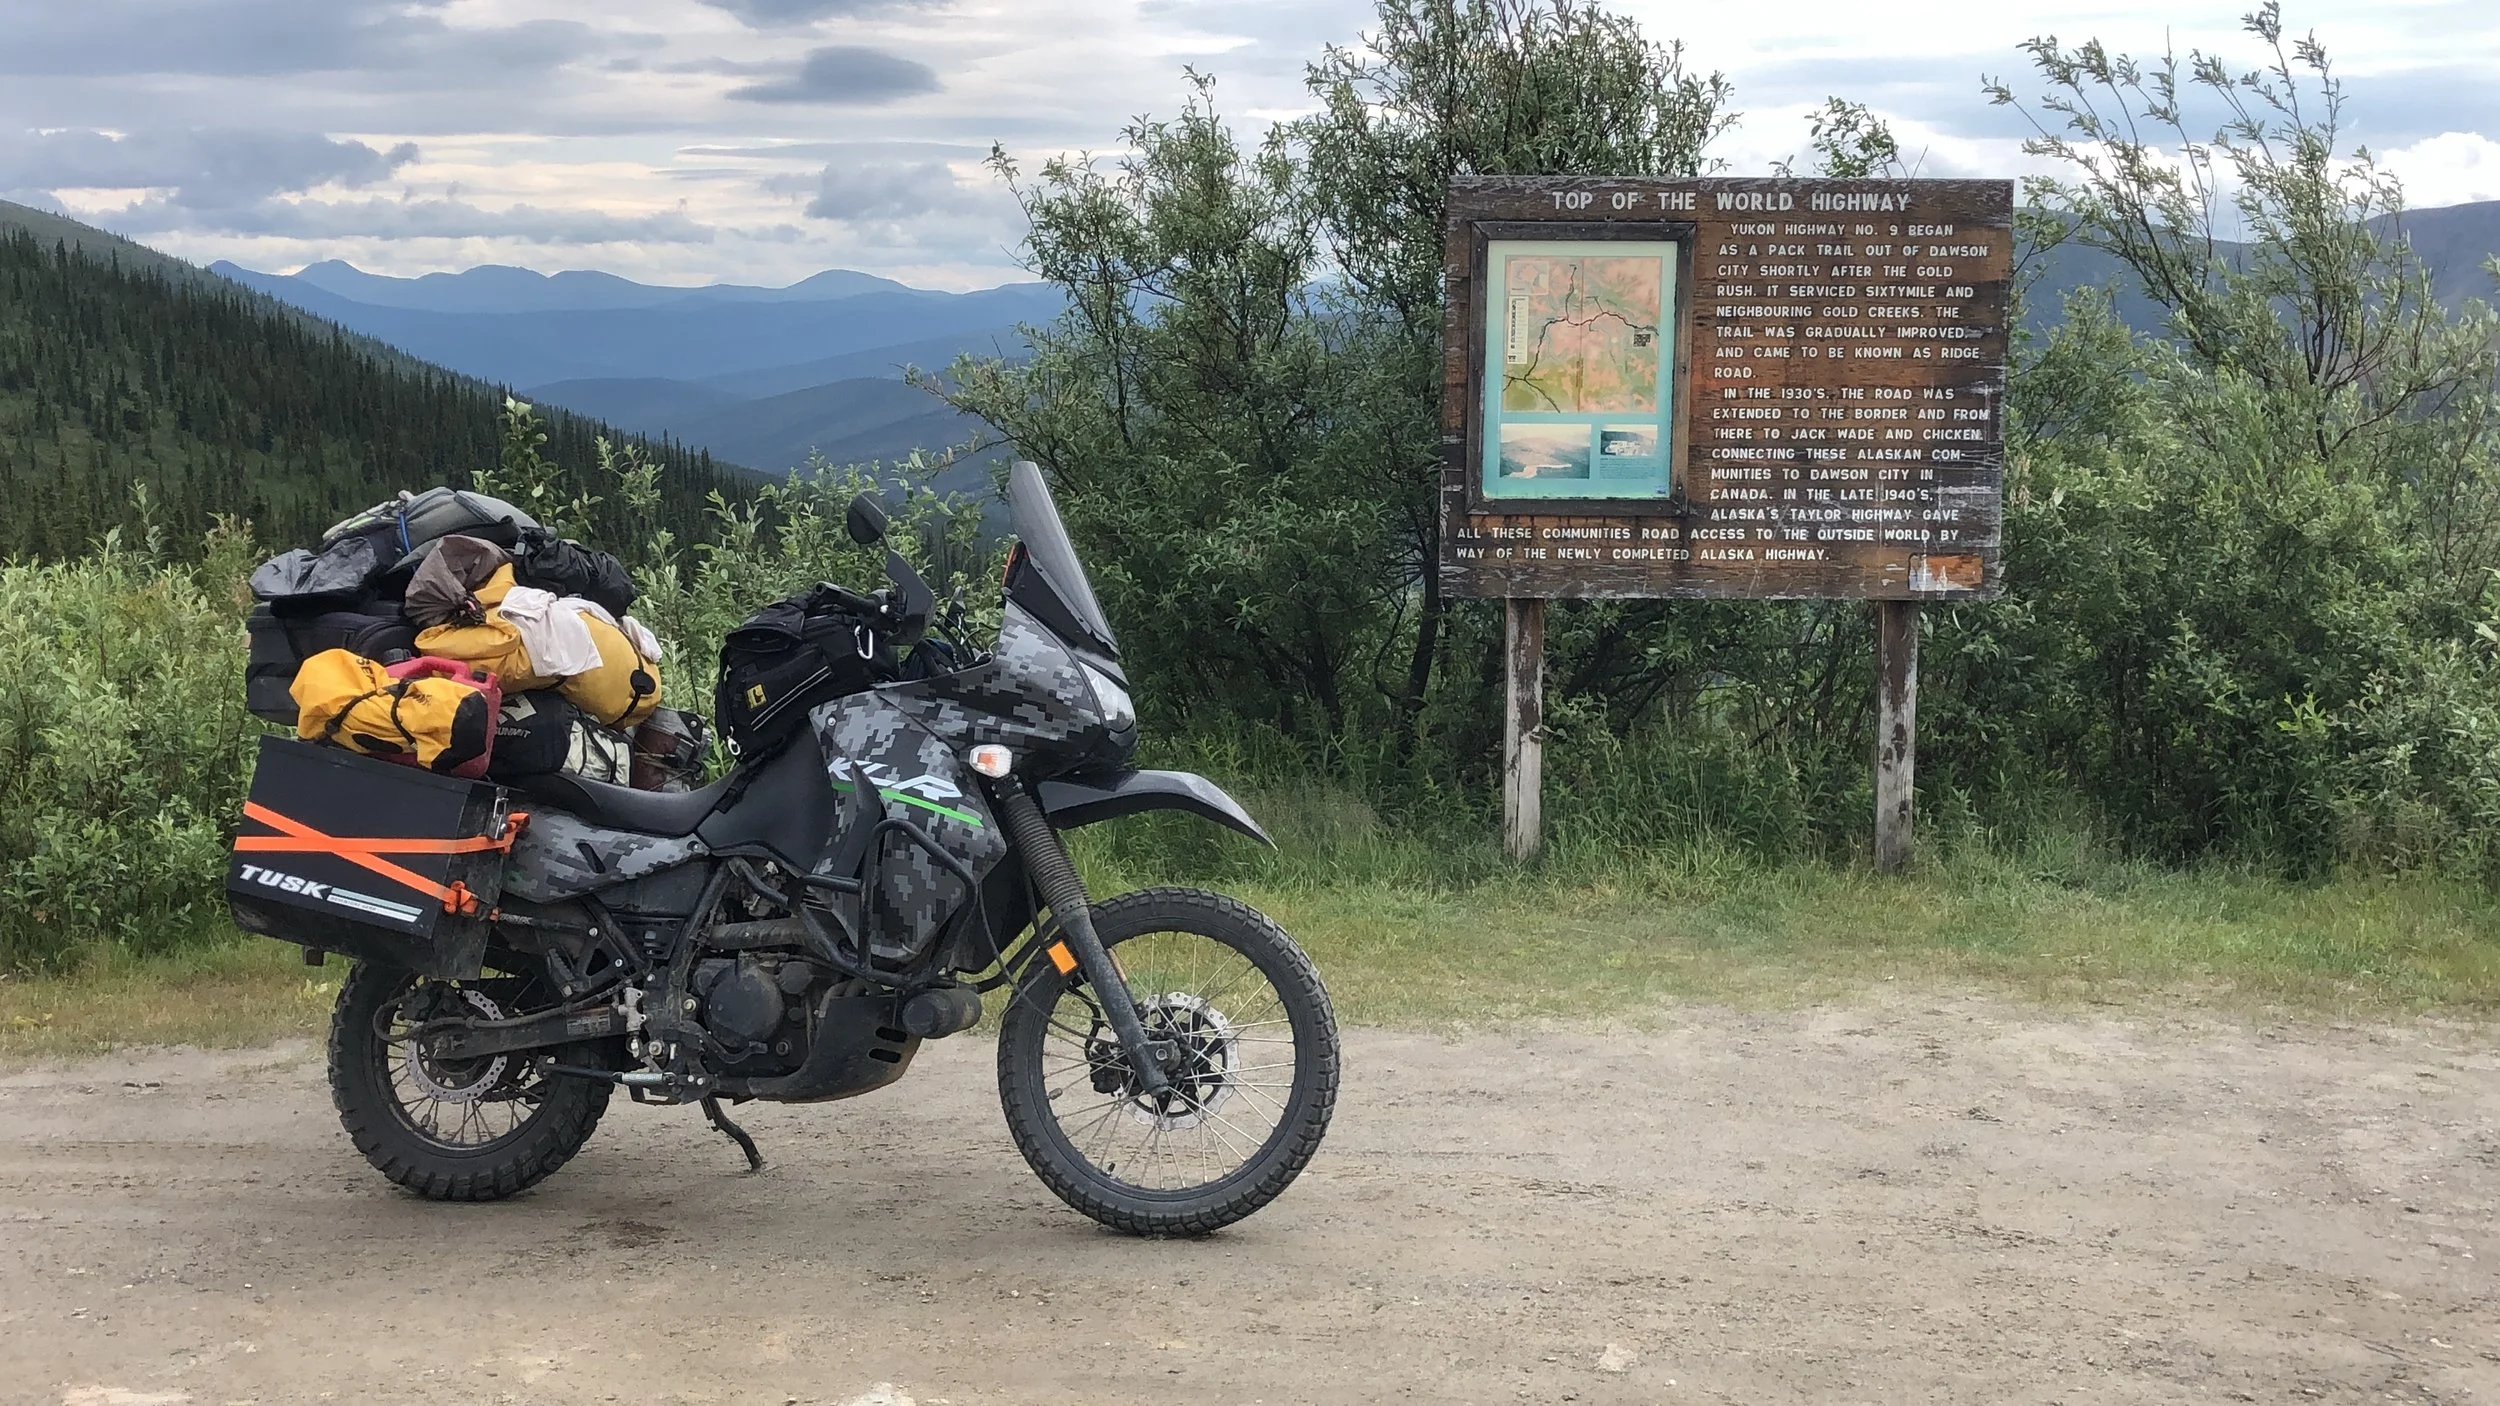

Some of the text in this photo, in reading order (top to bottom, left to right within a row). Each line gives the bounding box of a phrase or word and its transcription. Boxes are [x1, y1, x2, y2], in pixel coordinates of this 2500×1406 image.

[1552, 191, 1910, 211] TOP OF THE WORLD HIGHWAY
[1730, 223, 1953, 236] YUKON HIGHWAY NO. 9 BEGAN
[1719, 244, 1989, 257] AS A PACK TRAIL OUT OF DAWSON
[1717, 264, 1953, 278] CITY SHORTLY AFTER THE GOLD
[1716, 285, 1974, 298] RUSH. IT SERVICED SIXTYMILE AND
[1716, 306, 1959, 319] NEIGHBOURING GOLD CREEKS. THE
[1716, 326, 1754, 338] TRAIL
[1764, 326, 1795, 338] WAS
[1805, 327, 1886, 338] GRADUALLY
[1715, 347, 1980, 359] AND CAME TO BE KNOWN AS RIDGE
[1714, 367, 1757, 379] ROAD.
[1724, 387, 1737, 399] IN
[1748, 387, 1771, 399] THE
[1841, 388, 1864, 399] THE
[1875, 388, 1912, 400] ROAD
[1923, 388, 1955, 400] WAS
[1713, 408, 1990, 421] EXTENDED TO THE BORDER AND FROM
[1714, 428, 1753, 440] THERE
[1763, 428, 1781, 440] TO
[1790, 428, 1826, 440] JACK
[1837, 428, 1875, 440] WADE
[1885, 428, 1913, 440] AND
[1711, 448, 1966, 460] CONNECTING THESE ALASKAN COM-
[1711, 468, 1934, 480] MUNITIES TO DAWSON CITY IN
[1710, 488, 1773, 500] CANADA.
[1783, 488, 1797, 500] IN
[1806, 488, 1830, 500] THE
[1840, 488, 1874, 500] LATE
[1711, 507, 1959, 521] ALASKA'S TAYLOR HIGHWAY GAVE
[1457, 527, 1959, 541] ALL THESE COMMUNITIES ROAD ACCESS TO THE OUTSIDE WORLD BY
[1457, 548, 1830, 561] WAY OF THE NEWLY COMPLETED ALASKA HIGHWAY.
[828, 757, 963, 801] KLR
[239, 864, 332, 900] TUSK
